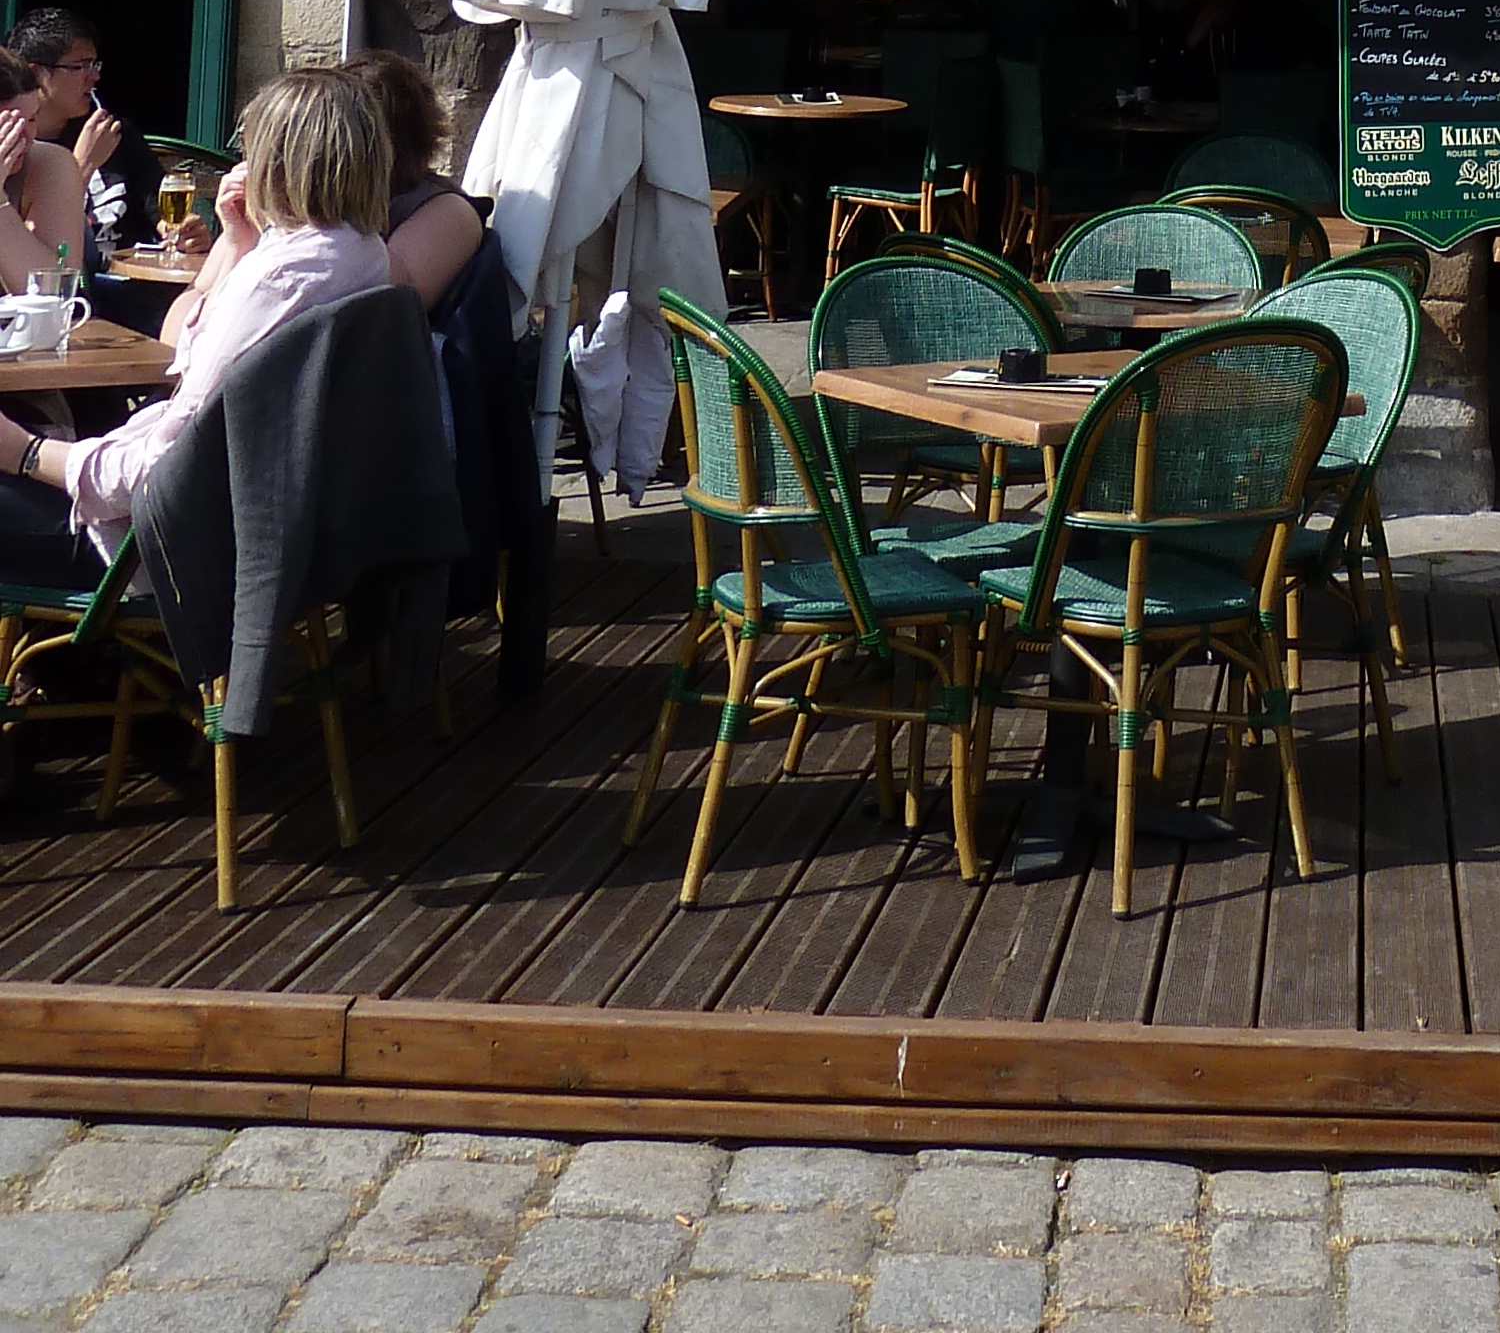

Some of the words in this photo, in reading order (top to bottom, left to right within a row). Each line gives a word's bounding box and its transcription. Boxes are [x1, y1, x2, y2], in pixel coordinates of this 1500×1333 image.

[1414, 5, 1466, 19] CHOCOLAT
[1358, 22, 1392, 39] TARTE
[1359, 47, 1398, 65] COUPES
[1361, 129, 1420, 141] STELLA
[1361, 139, 1421, 151] ARTOIS
[1367, 153, 1415, 162] BLONDE
[1352, 167, 1432, 189] Hoegaarden
[1364, 188, 1419, 198] BLANCHE
[1405, 210, 1430, 221] PRIX
[1432, 210, 1453, 221] NET
